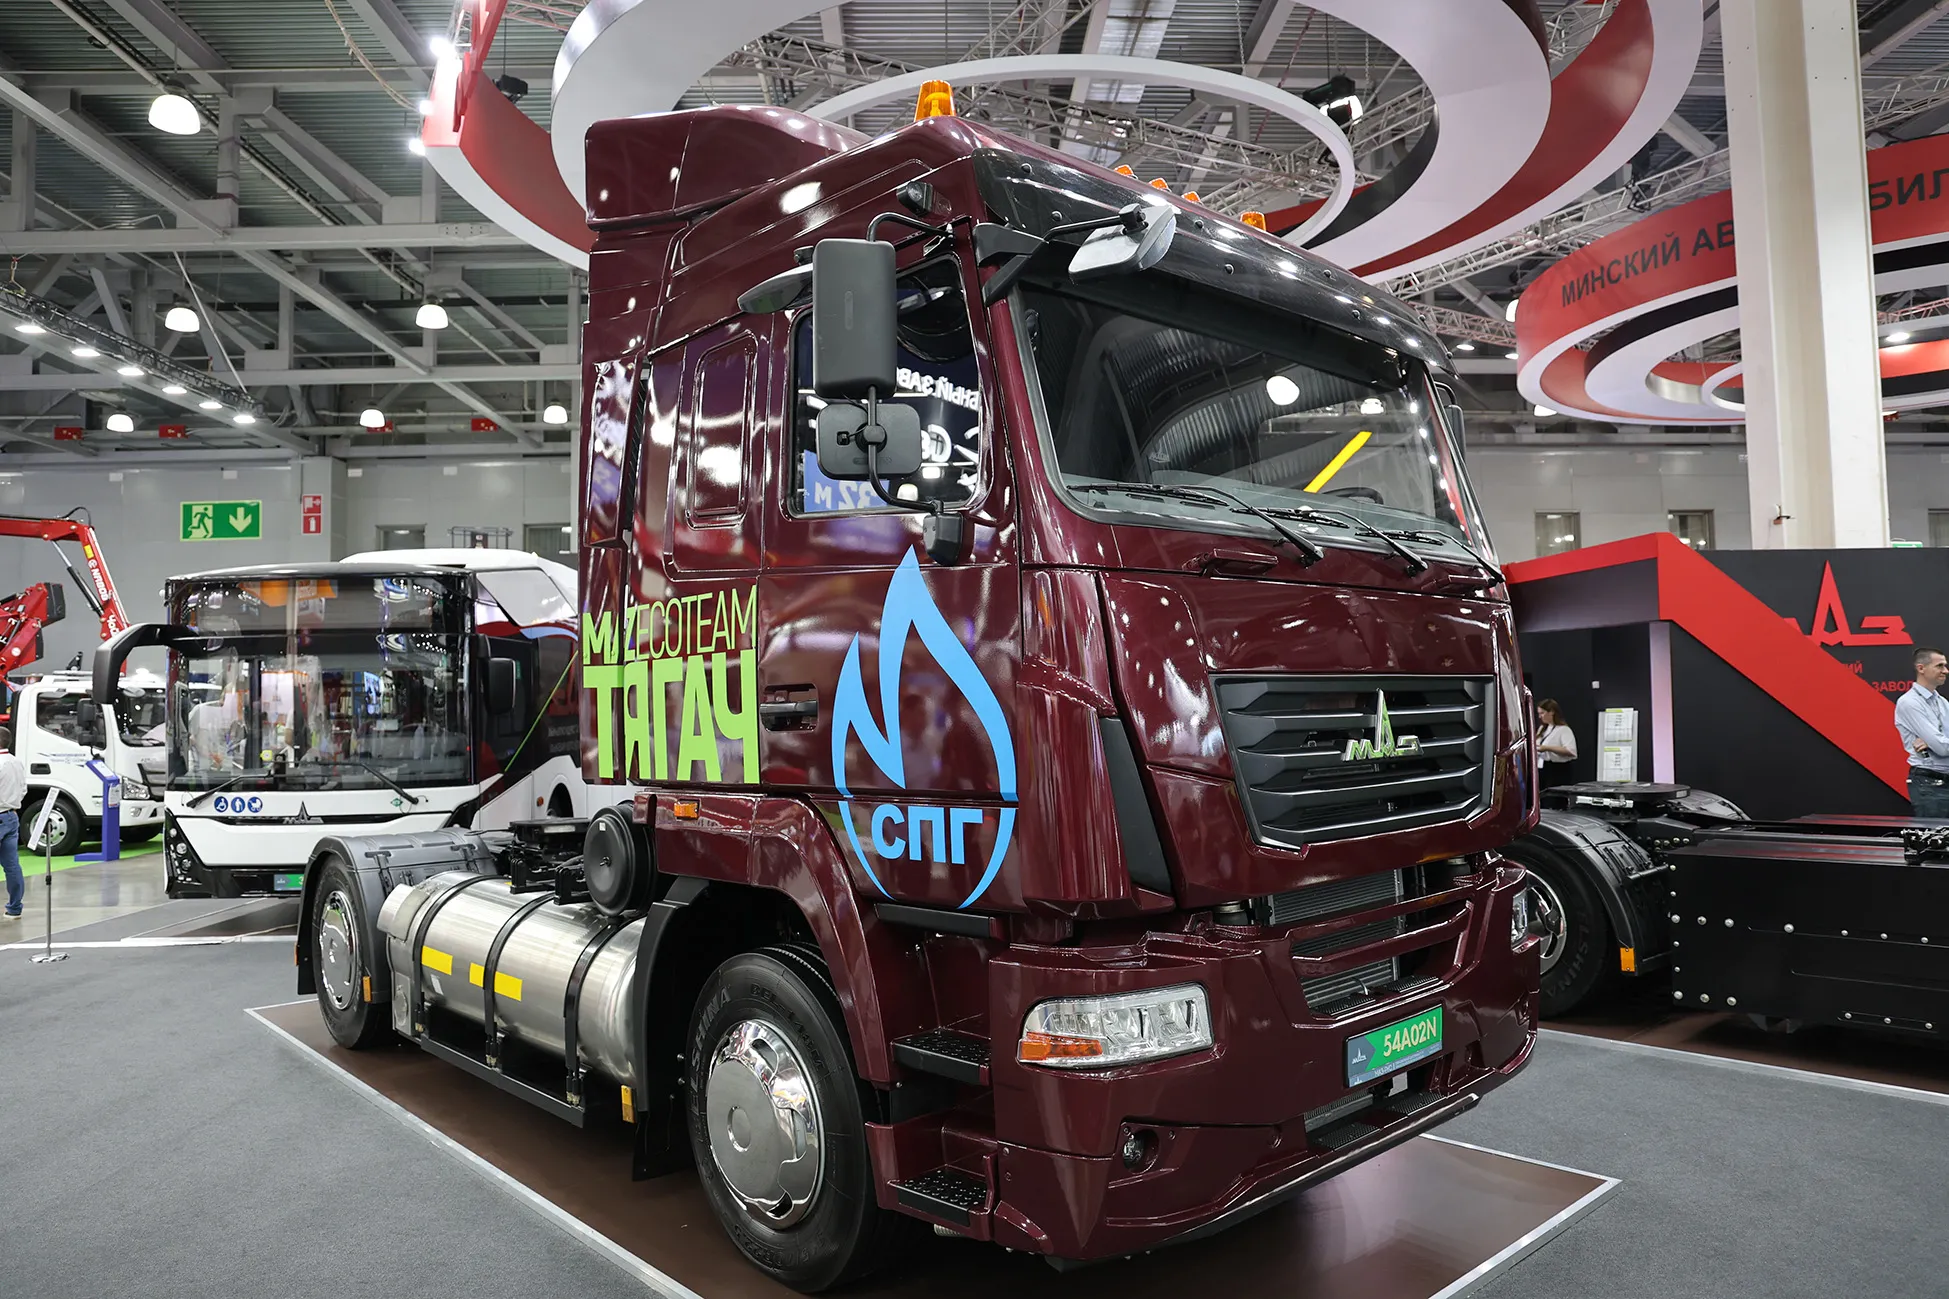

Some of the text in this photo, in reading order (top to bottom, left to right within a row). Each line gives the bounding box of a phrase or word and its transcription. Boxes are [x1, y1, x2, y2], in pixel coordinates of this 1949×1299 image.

[1561, 232, 1681, 308] МИНСКИЙ
[1783, 559, 1914, 647] АЗ
[583, 649, 760, 784] ТЯГАЧ
[871, 803, 983, 865] СПГ
[1383, 1016, 1437, 1057] 54A02N
